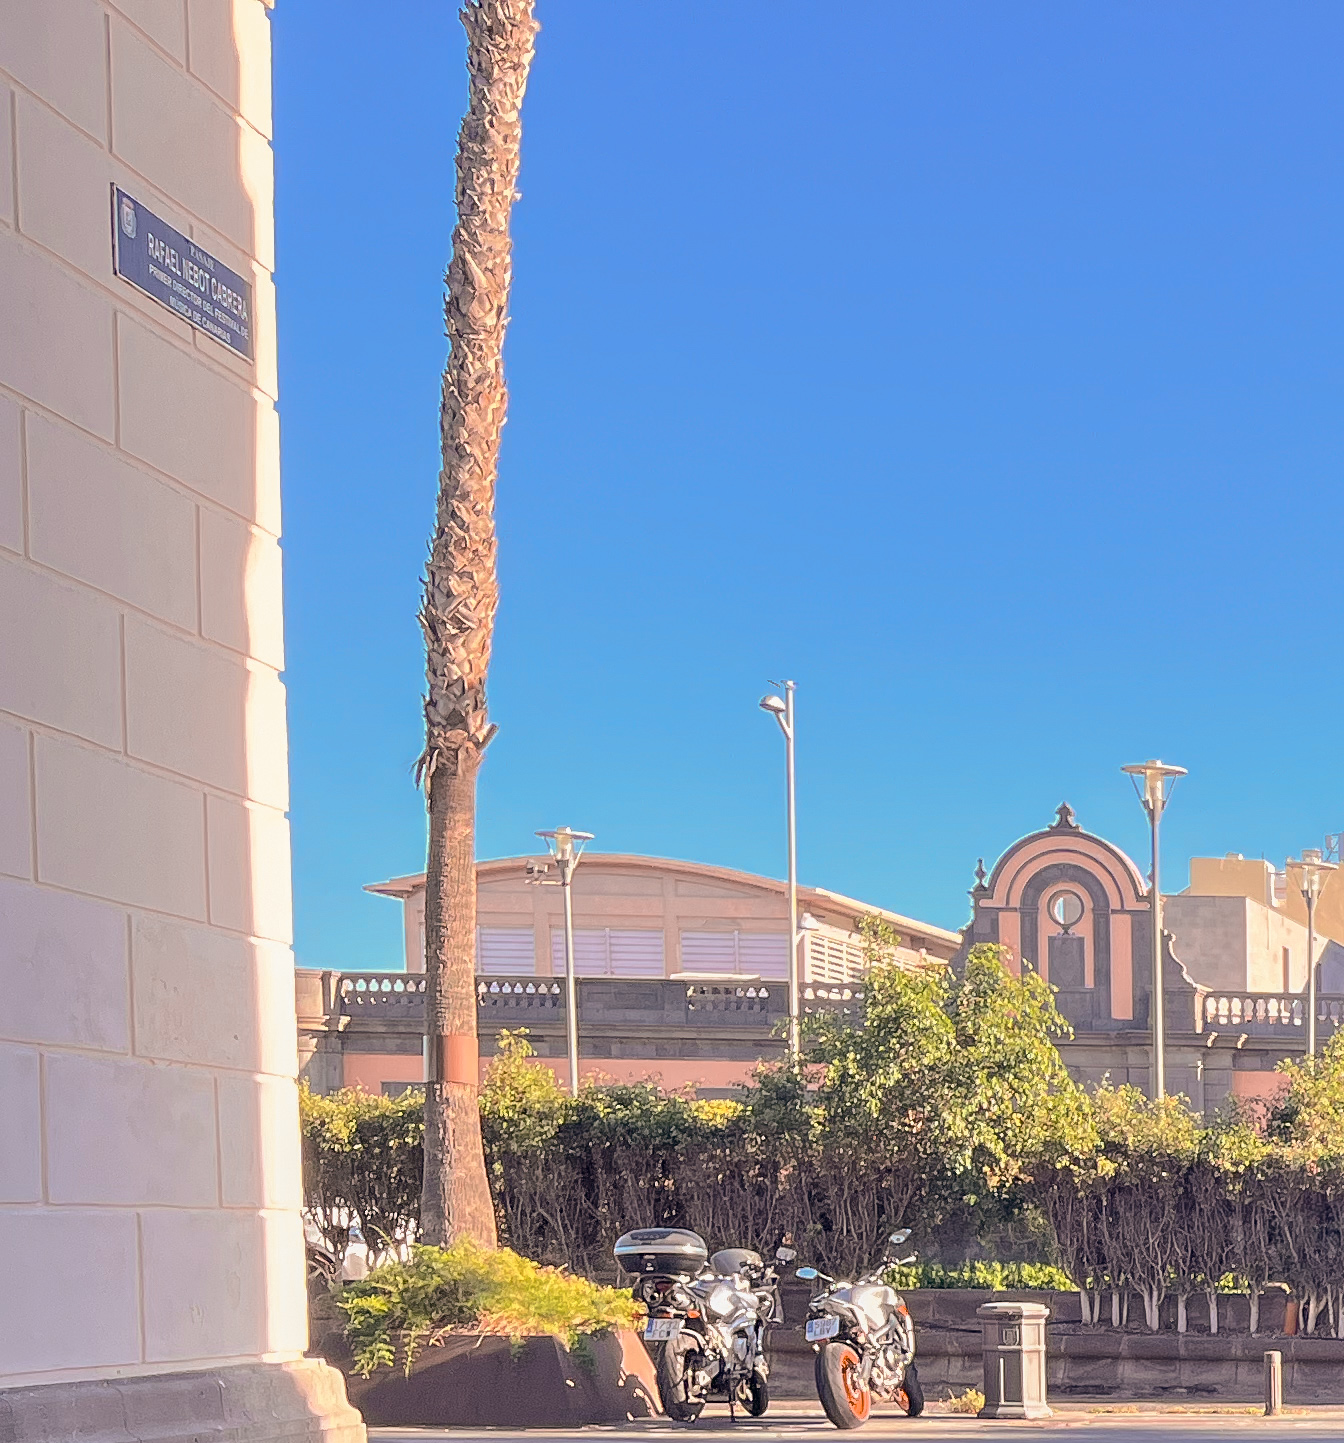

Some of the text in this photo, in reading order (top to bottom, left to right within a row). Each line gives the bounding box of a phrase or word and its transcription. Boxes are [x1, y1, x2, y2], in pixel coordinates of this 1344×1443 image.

[147, 232, 249, 322] RAFAEL NEBOT CABRERA
[148, 263, 249, 340] PRIMER DIRECTOR DEL FESTIVAL DE
[192, 310, 202, 325] DE
[201, 316, 231, 344] CANARIAS
